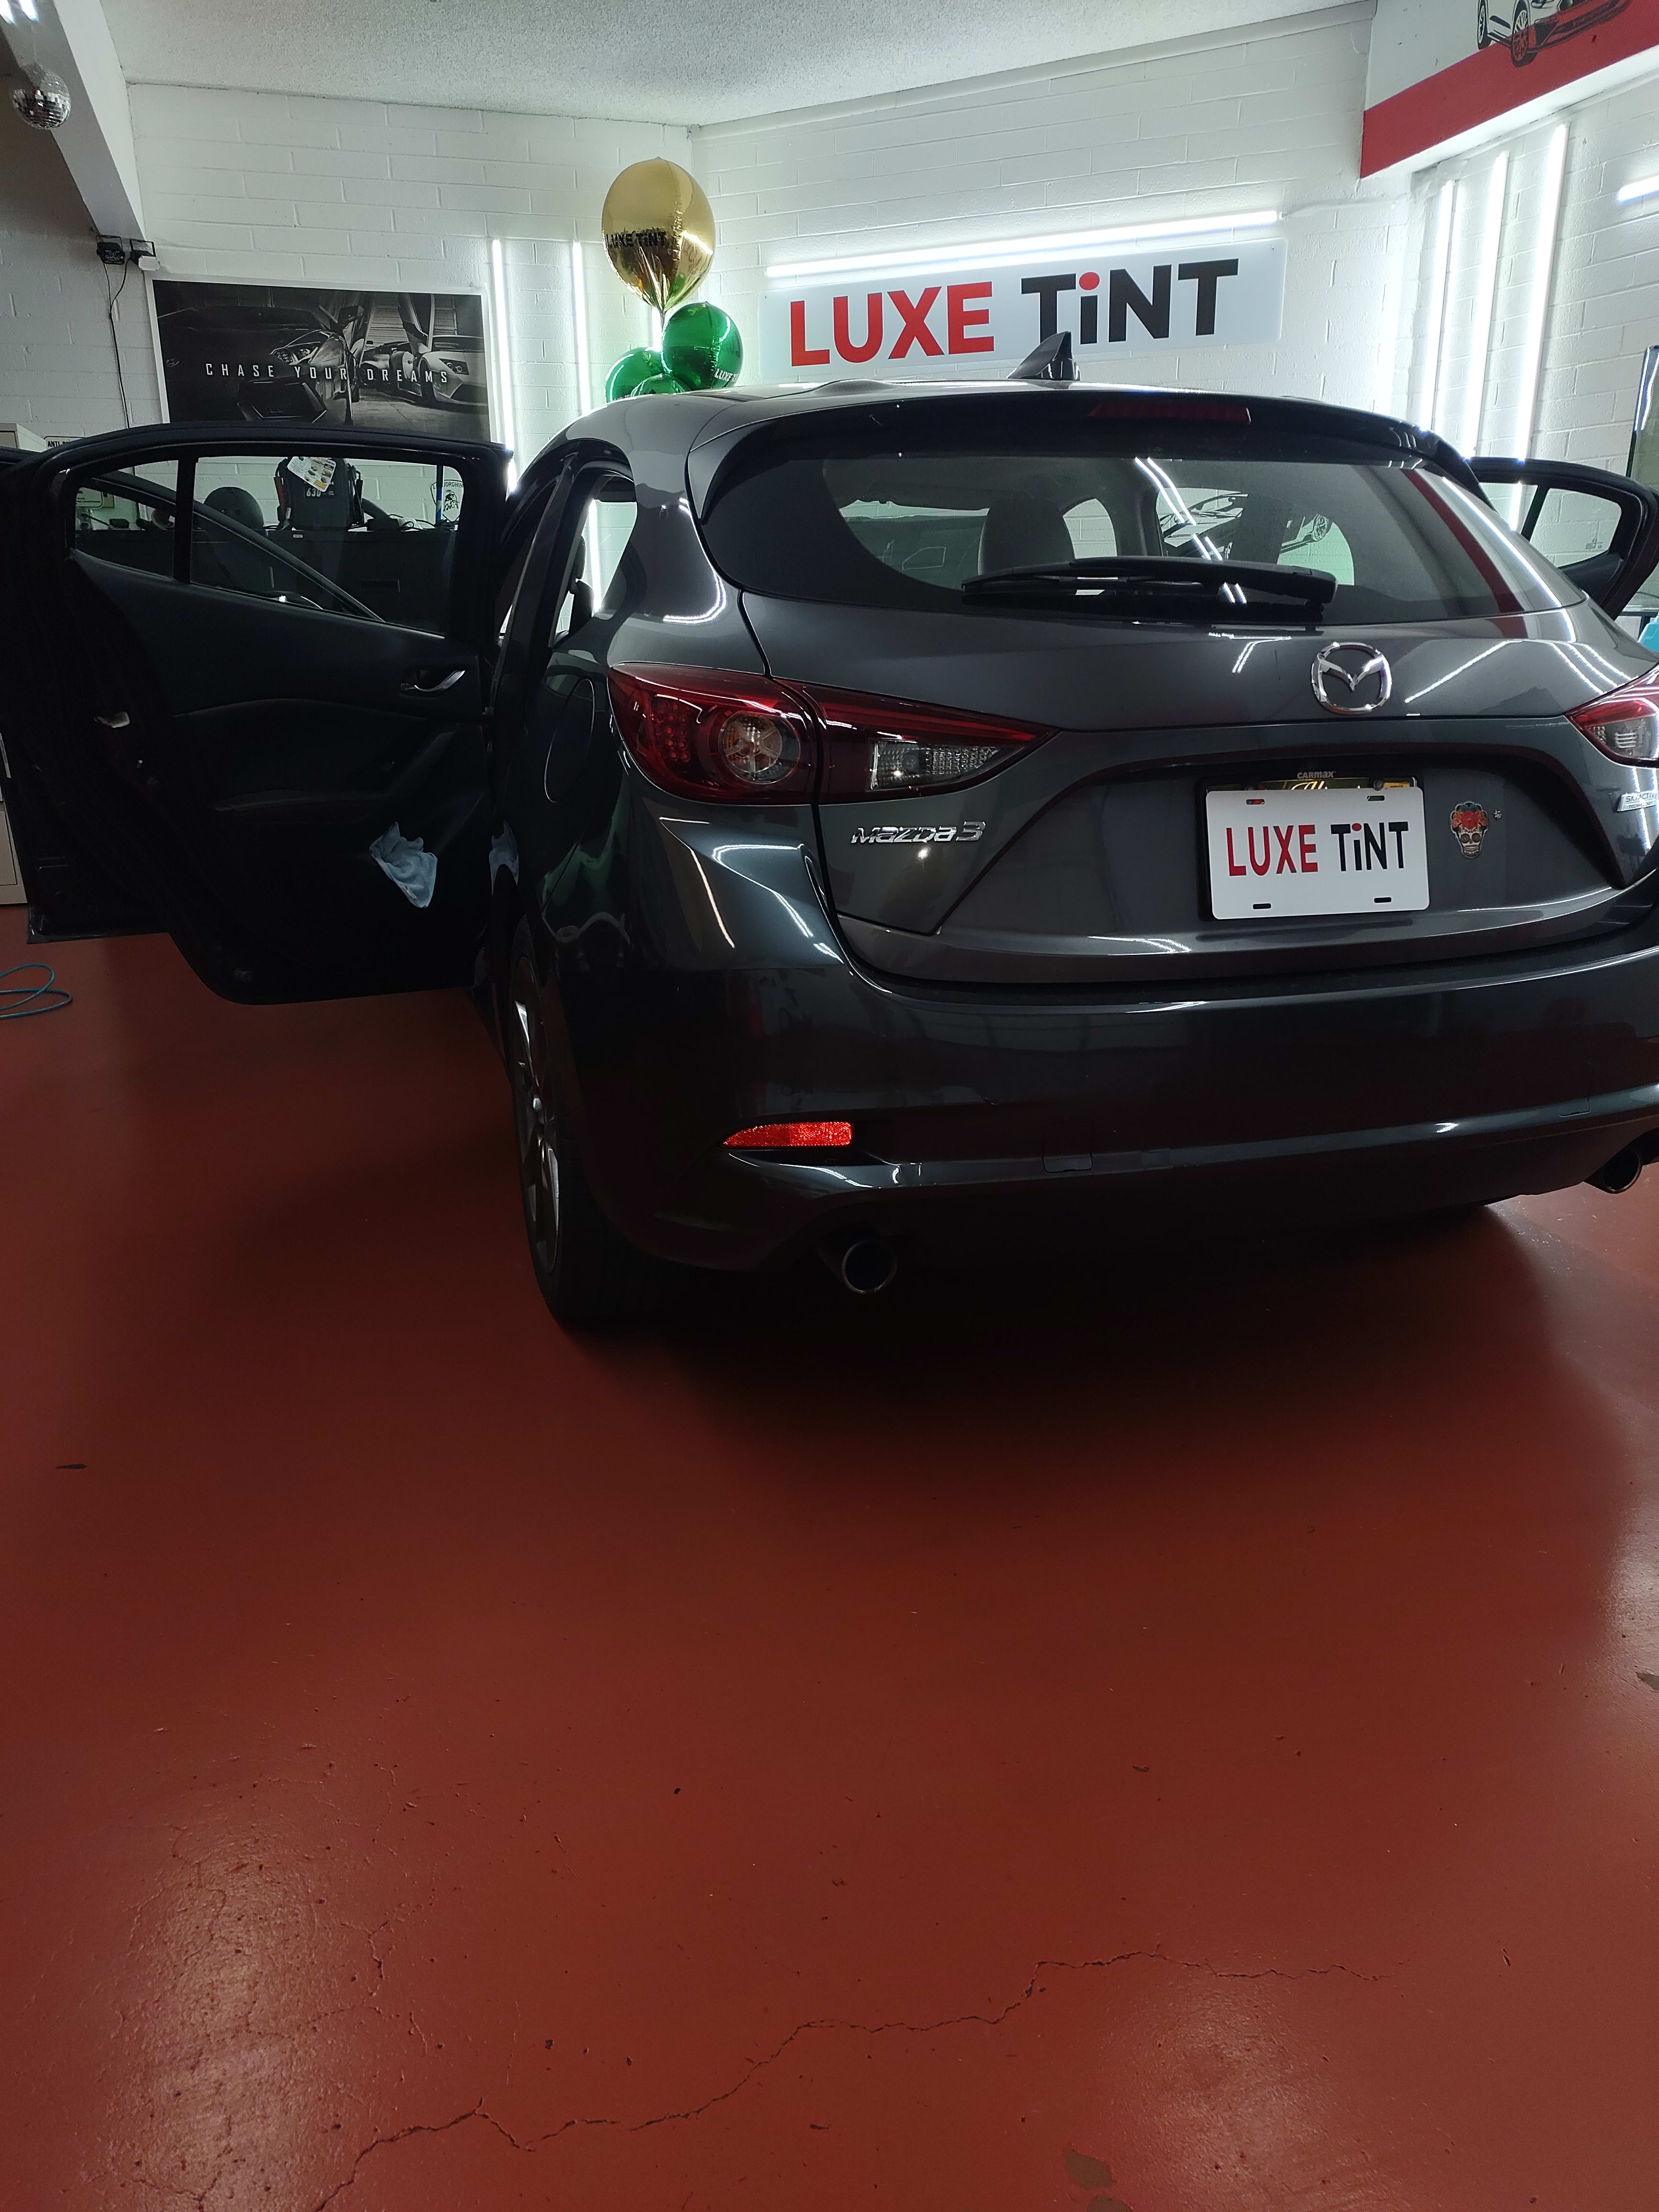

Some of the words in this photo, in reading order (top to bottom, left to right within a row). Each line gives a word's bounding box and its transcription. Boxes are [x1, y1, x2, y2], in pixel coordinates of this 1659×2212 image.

[790, 281, 995, 367] LUXE
[206, 364, 274, 377] CHASE
[294, 366, 347, 380] YOUR
[367, 369, 448, 384] DREAMS
[1227, 824, 1318, 876] LUXE
